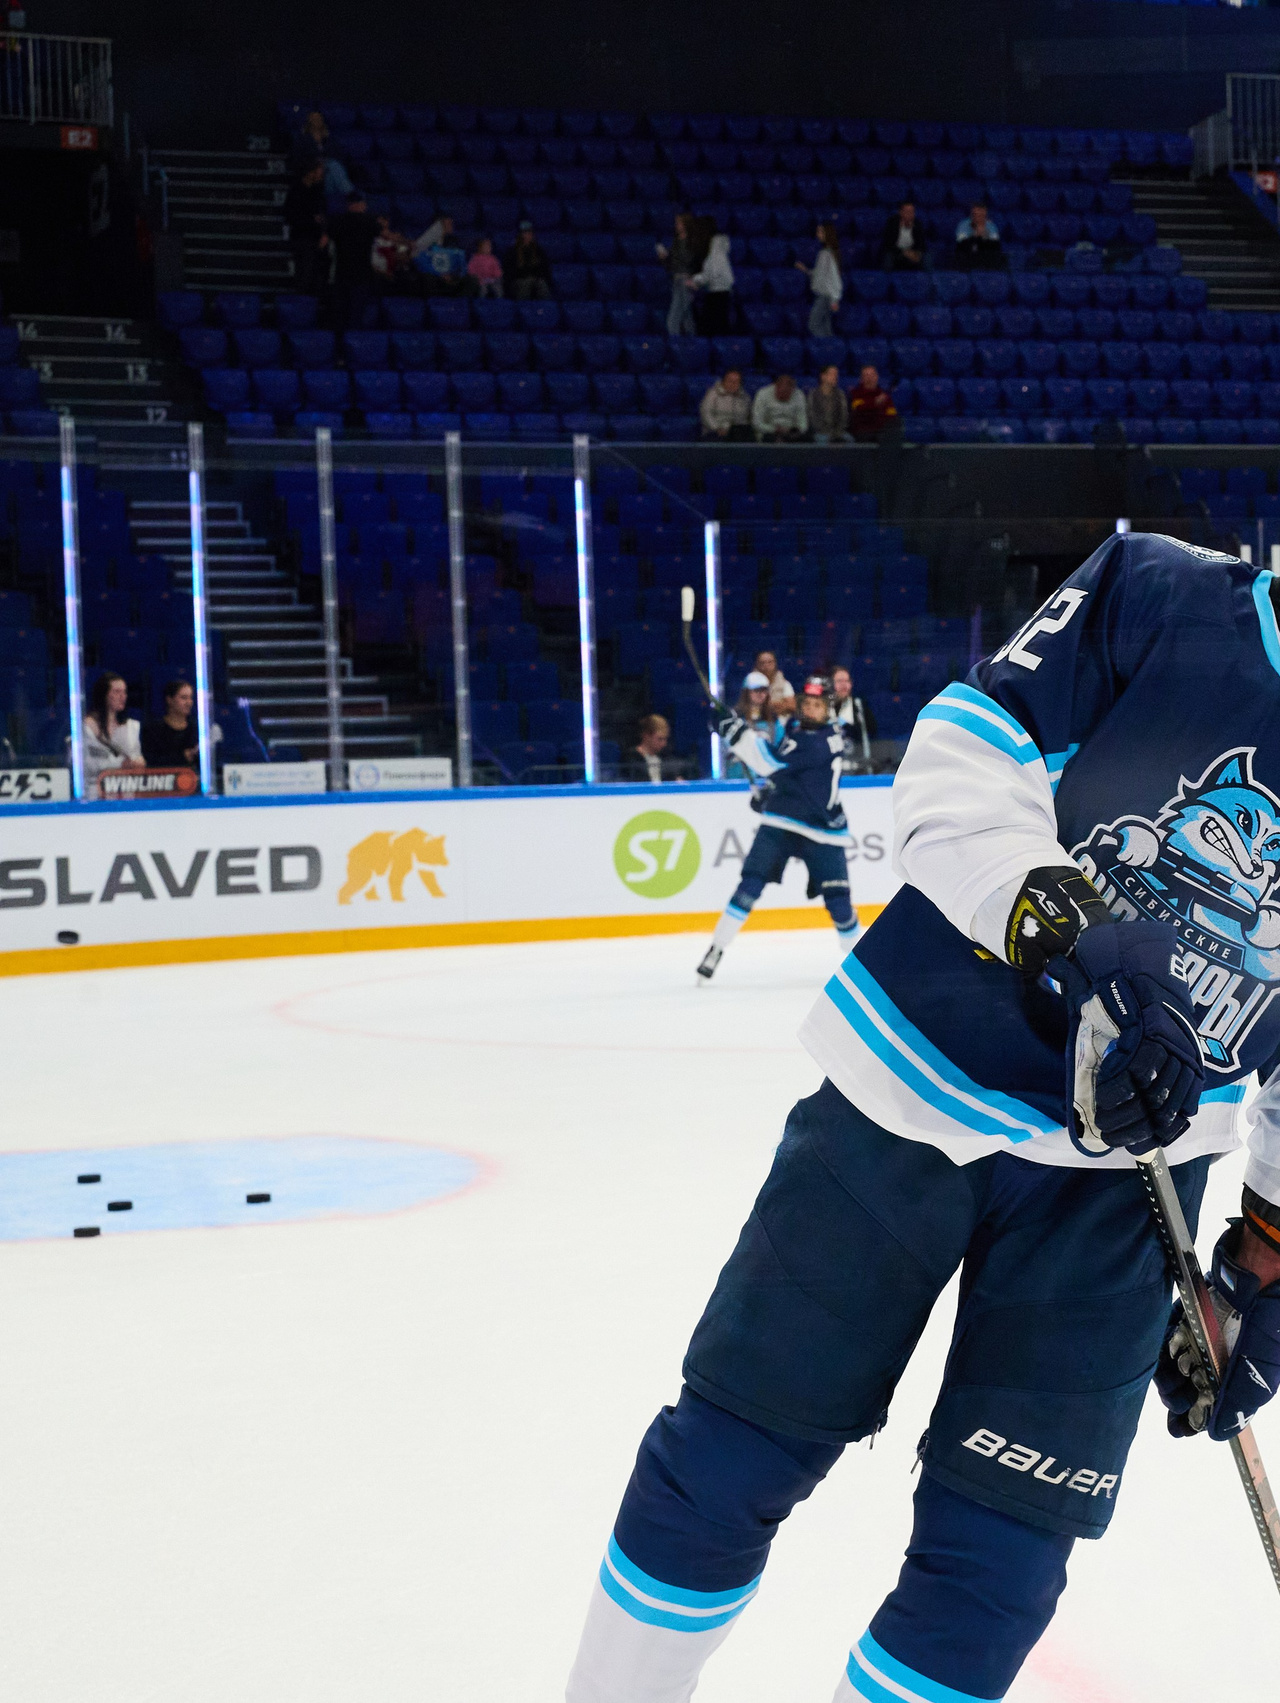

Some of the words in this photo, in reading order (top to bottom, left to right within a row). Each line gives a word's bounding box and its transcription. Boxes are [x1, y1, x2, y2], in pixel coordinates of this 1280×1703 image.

[990, 587, 1089, 671] 2
[104, 774, 176, 794] WINLINE
[626, 828, 688, 883] S7
[1124, 876, 1231, 959] СИБИРСКИЕ
